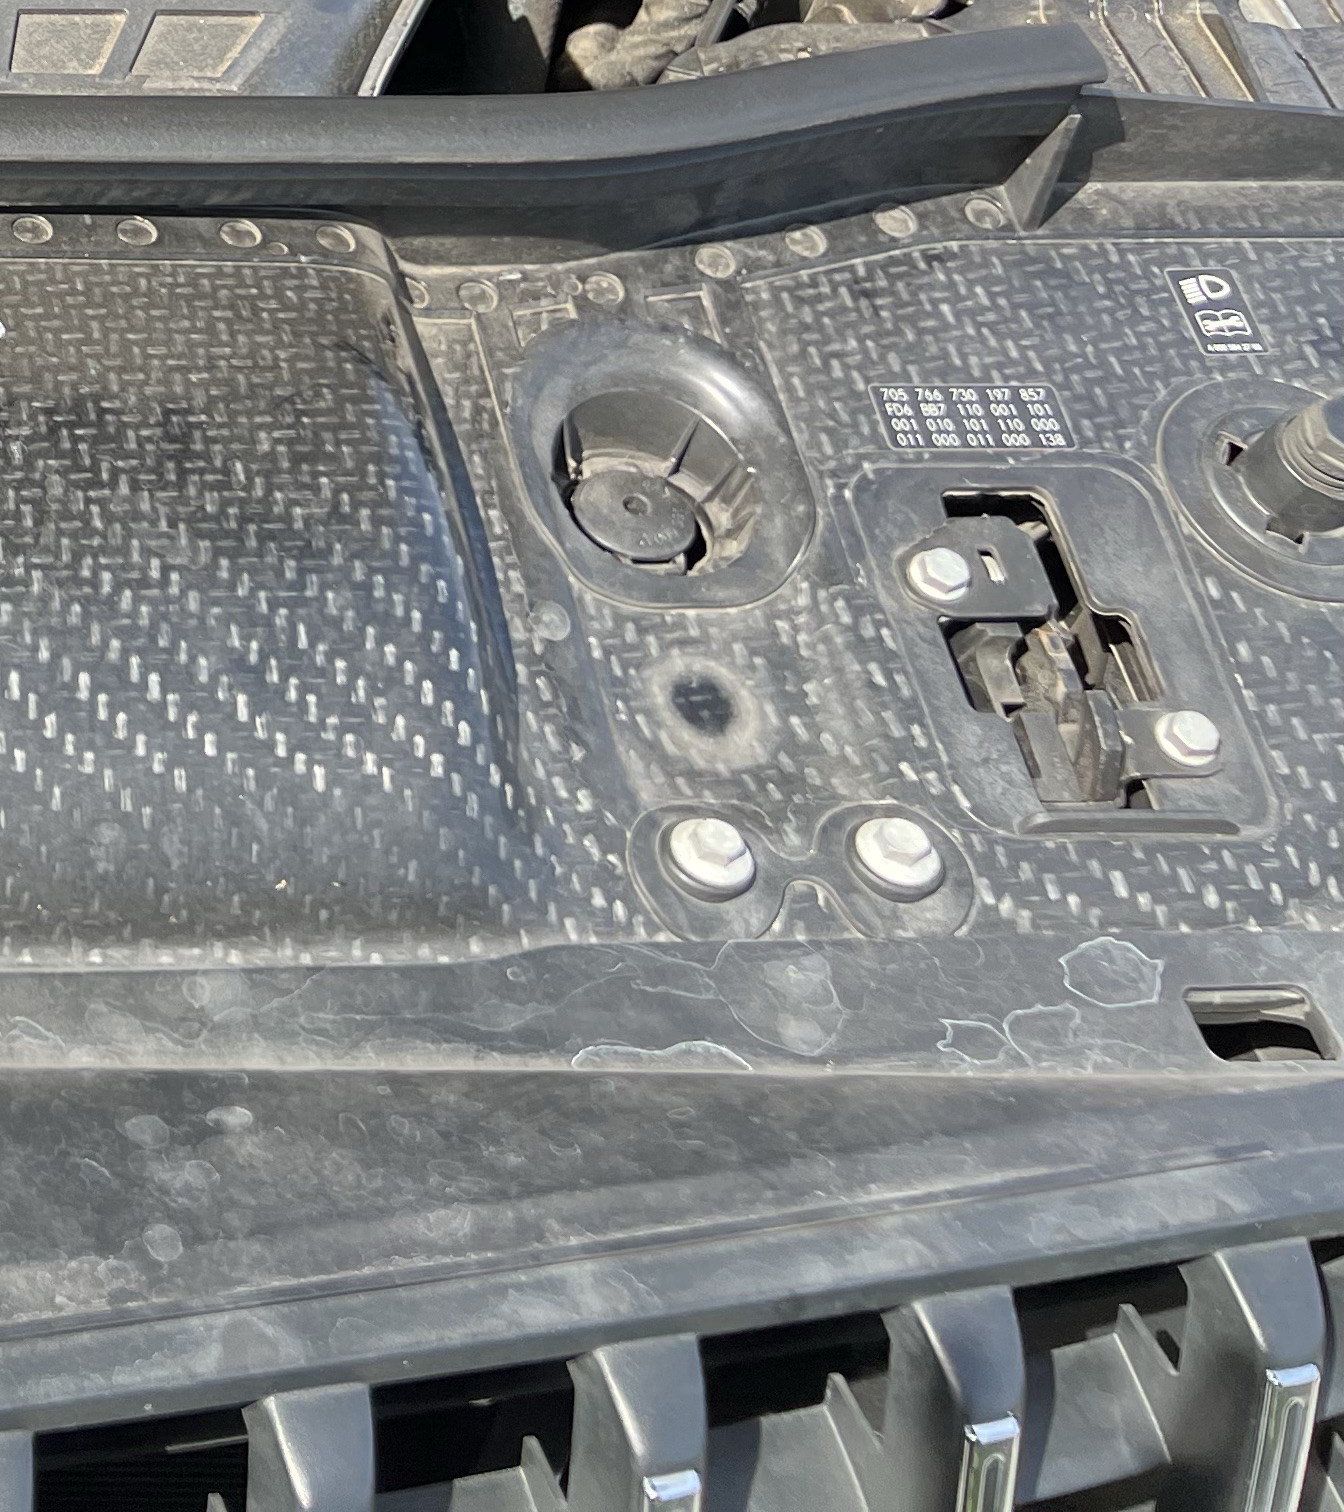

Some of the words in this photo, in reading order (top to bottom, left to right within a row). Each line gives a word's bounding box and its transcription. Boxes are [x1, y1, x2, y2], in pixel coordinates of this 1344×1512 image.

[880, 387, 908, 401] 705
[915, 387, 944, 401] 766
[949, 387, 979, 401] 730
[986, 387, 1011, 401] 197
[1019, 387, 1045, 401] 857
[885, 402, 913, 417] FD6
[956, 402, 983, 417] 110
[990, 402, 1018, 417] 001
[1027, 402, 1053, 417] 101
[891, 418, 918, 432] 001
[926, 418, 955, 432] 010
[963, 418, 989, 432] 101
[998, 418, 1025, 432] 110
[1031, 418, 1060, 432] 000
[897, 433, 924, 447] 011
[932, 433, 961, 447] 000
[967, 433, 995, 447] 011
[1002, 433, 1031, 447] 000
[1038, 433, 1067, 447] 138
